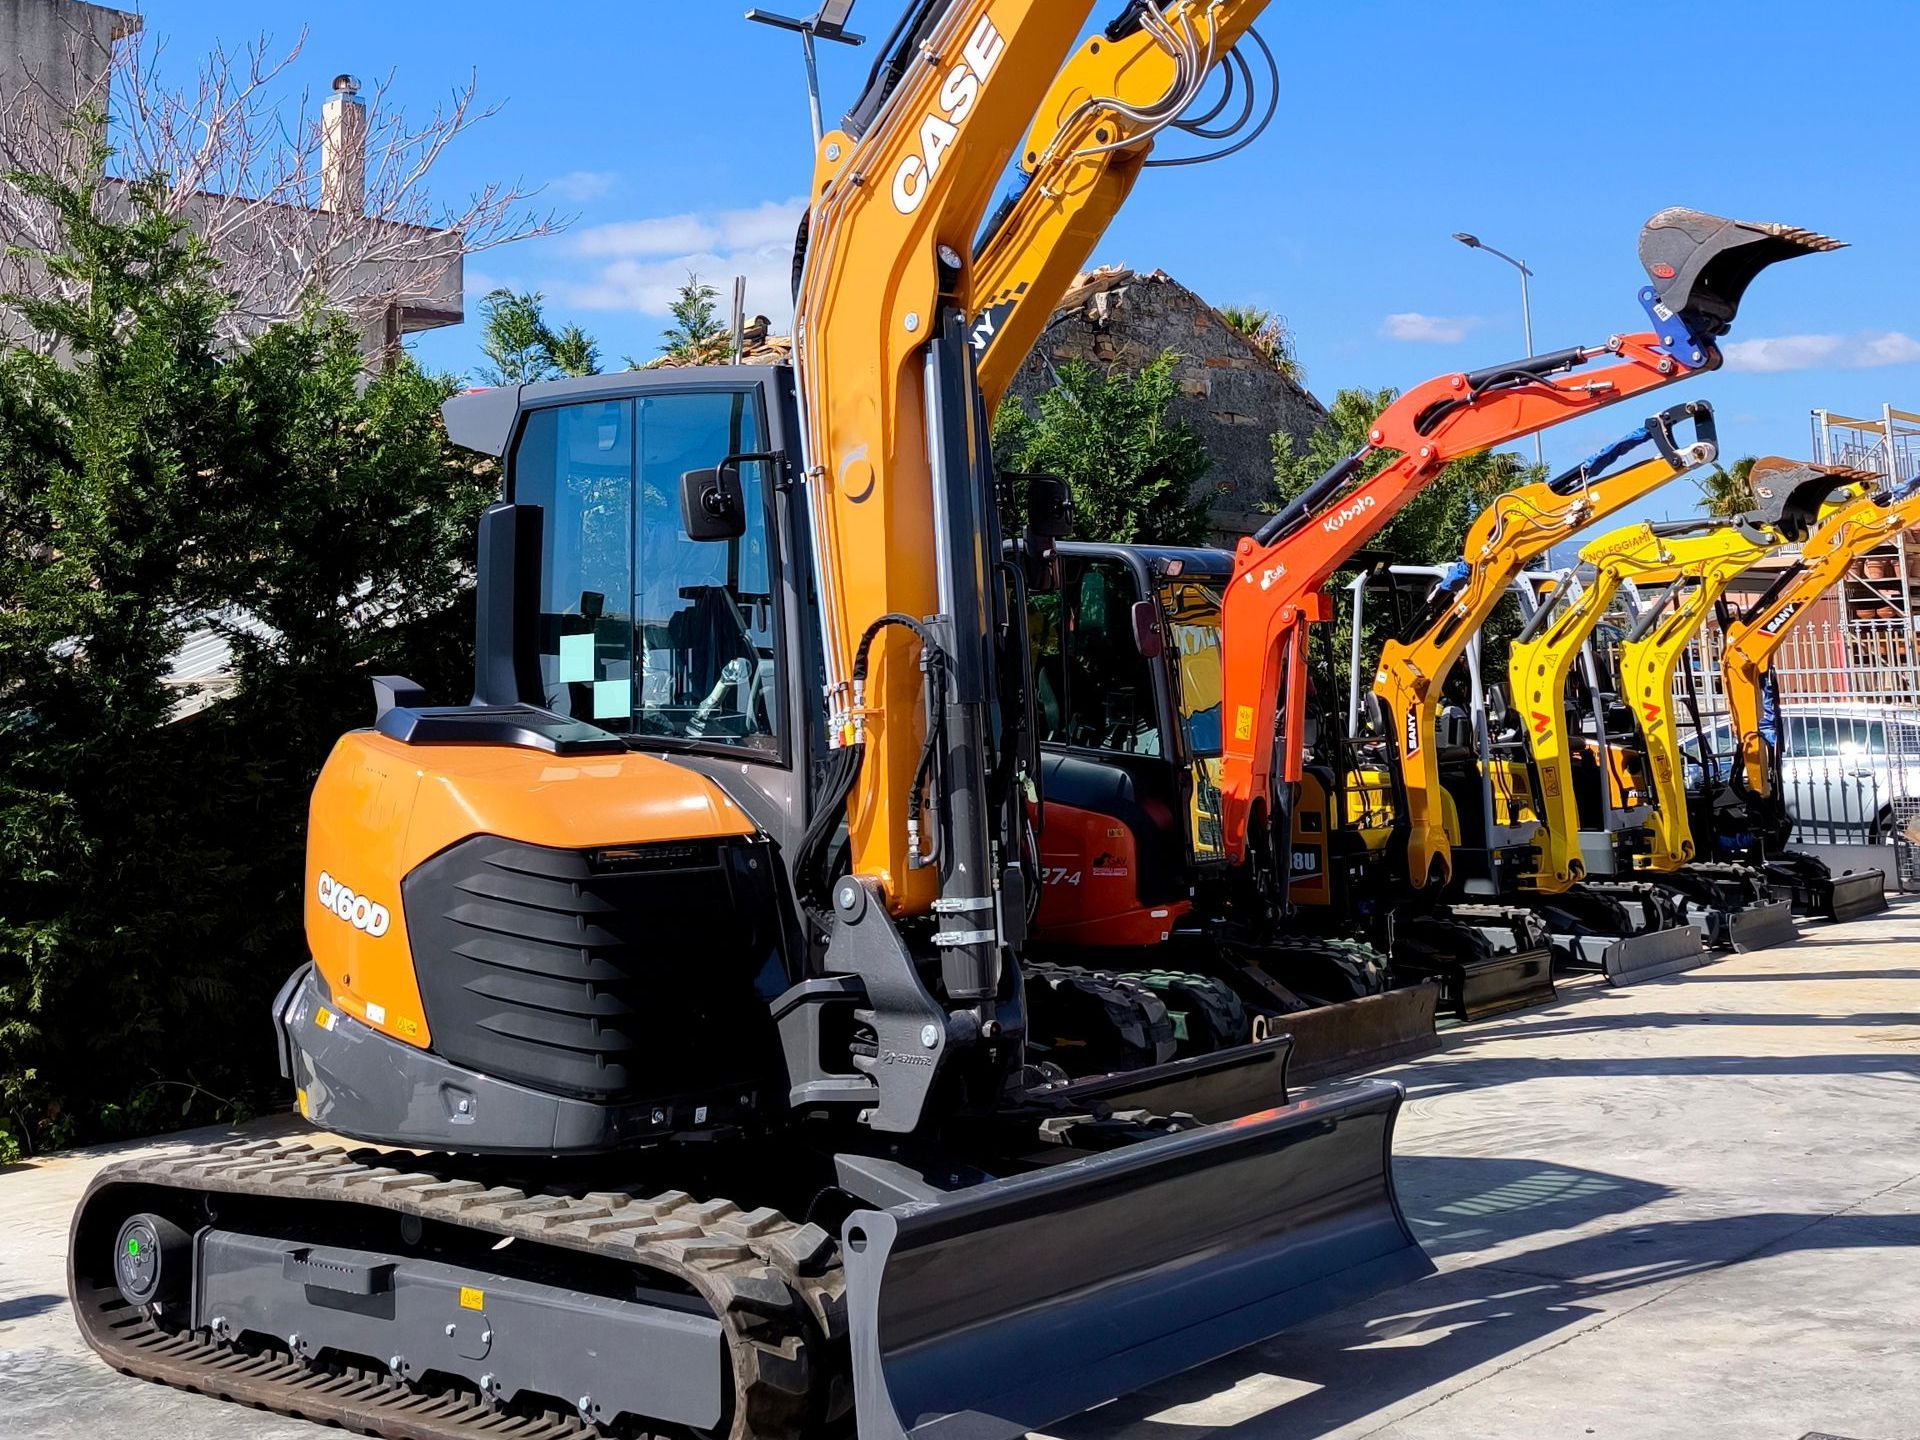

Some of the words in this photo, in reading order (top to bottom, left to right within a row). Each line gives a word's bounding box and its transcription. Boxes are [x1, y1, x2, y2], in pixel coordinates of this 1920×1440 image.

[892, 12, 1006, 214] CASE
[1322, 495, 1376, 533] Kubota
[1767, 604, 1794, 632] SANY
[1407, 714, 1417, 749] SANY
[317, 870, 390, 937] CX60D
